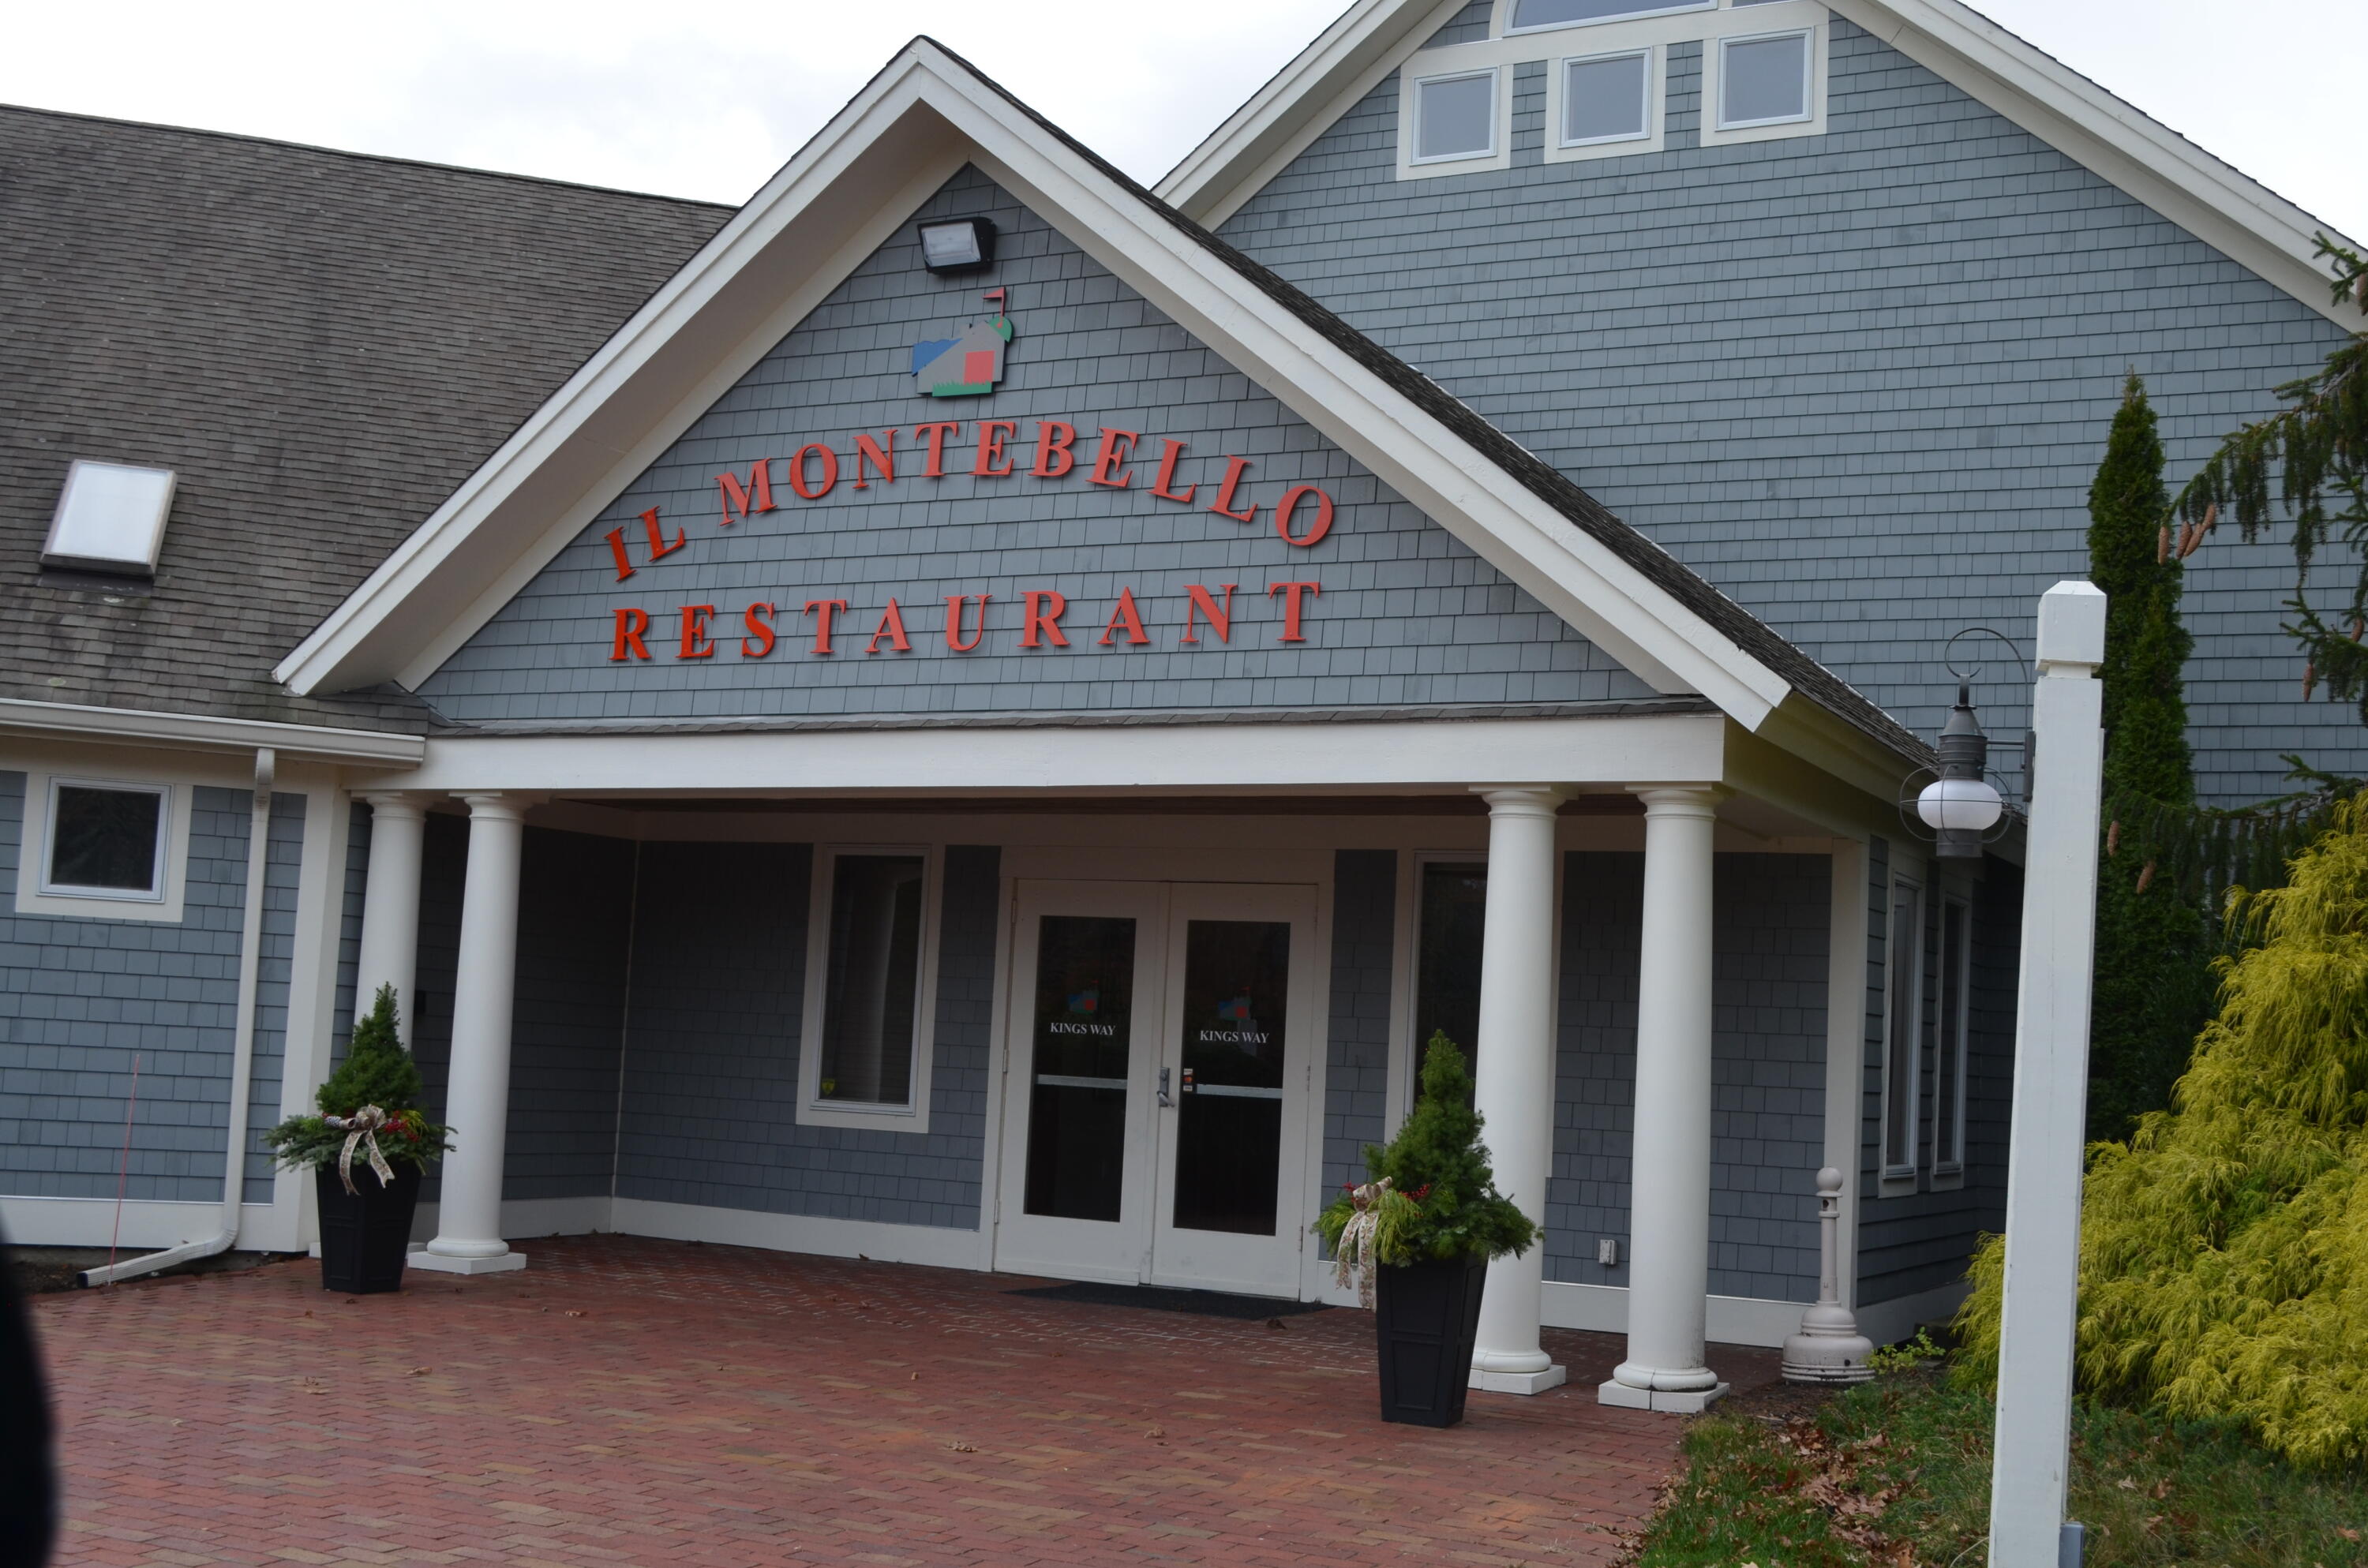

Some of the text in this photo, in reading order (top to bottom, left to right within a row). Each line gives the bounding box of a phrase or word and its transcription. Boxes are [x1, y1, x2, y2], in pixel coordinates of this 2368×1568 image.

[604, 421, 1333, 582] IL MONTEBELLO
[609, 582, 1321, 661] RESTAURANT
[1051, 1022, 1116, 1035] KINGS WAY
[1200, 1031, 1269, 1043] KINGS WAY
